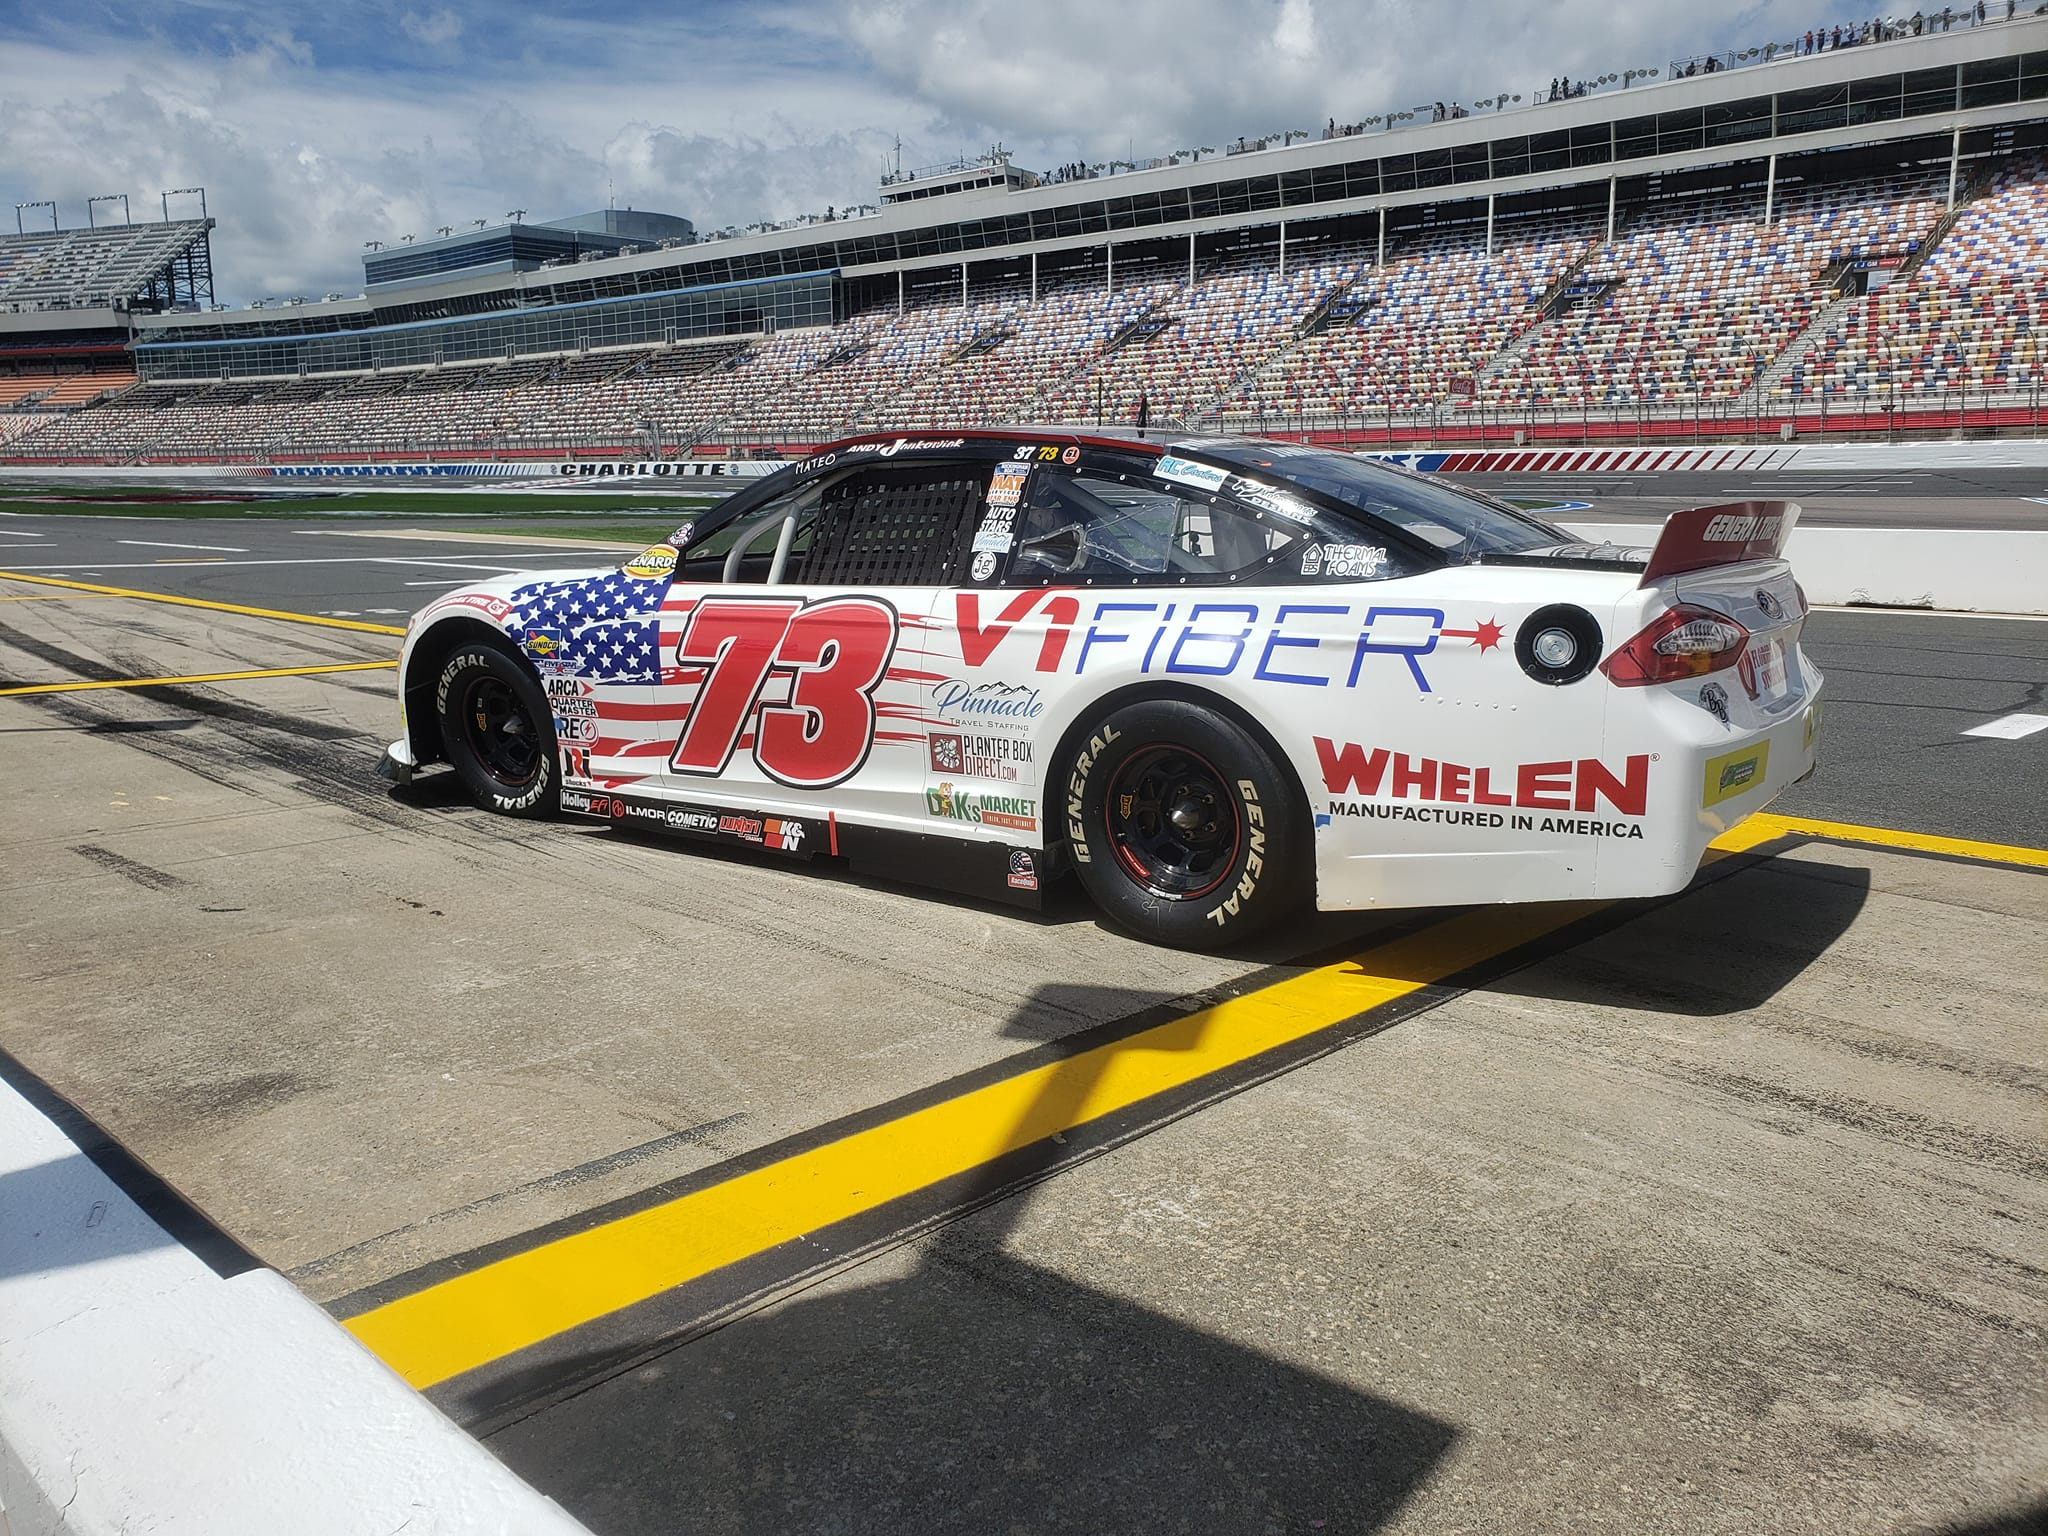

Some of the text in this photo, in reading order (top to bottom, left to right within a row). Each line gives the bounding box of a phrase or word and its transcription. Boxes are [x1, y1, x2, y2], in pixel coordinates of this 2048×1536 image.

[846, 444, 884, 453] ANDY
[1013, 446, 1036, 460] 37
[1038, 446, 1059, 460] 73
[560, 463, 726, 476] CHARLOTTE
[795, 453, 836, 475] MATEO
[990, 475, 1025, 491] MAT
[985, 507, 1017, 520] AUTO
[979, 519, 1013, 533] STARS
[1703, 514, 1763, 541] GENERAL
[1324, 544, 1387, 563] THERMAL
[975, 556, 993, 575] jg
[1303, 564, 1318, 573] EPS
[1326, 560, 1376, 576] FOAMS
[528, 641, 558, 649] SUNOCO
[436, 653, 490, 715] GENERAL
[548, 679, 579, 696] ARCA
[669, 595, 898, 791] 73
[551, 697, 593, 709] QUARTER
[932, 679, 1045, 719] Pinnacle
[560, 705, 596, 716] MASTER
[949, 717, 1029, 732] TRAVEL STAFFING
[964, 735, 1033, 763] PLANTER BOX
[493, 753, 550, 810] GENERAL
[1312, 735, 1650, 817] WHELEN
[562, 791, 590, 811] Holley
[1067, 724, 1122, 863] GENERAL
[626, 805, 666, 820] ILMOR
[980, 794, 1036, 817] MARKET
[667, 810, 718, 829] COMETIC
[1329, 801, 1645, 840] MANUFACTURED IN AMERICA
[1206, 779, 1266, 927] GENERAL
